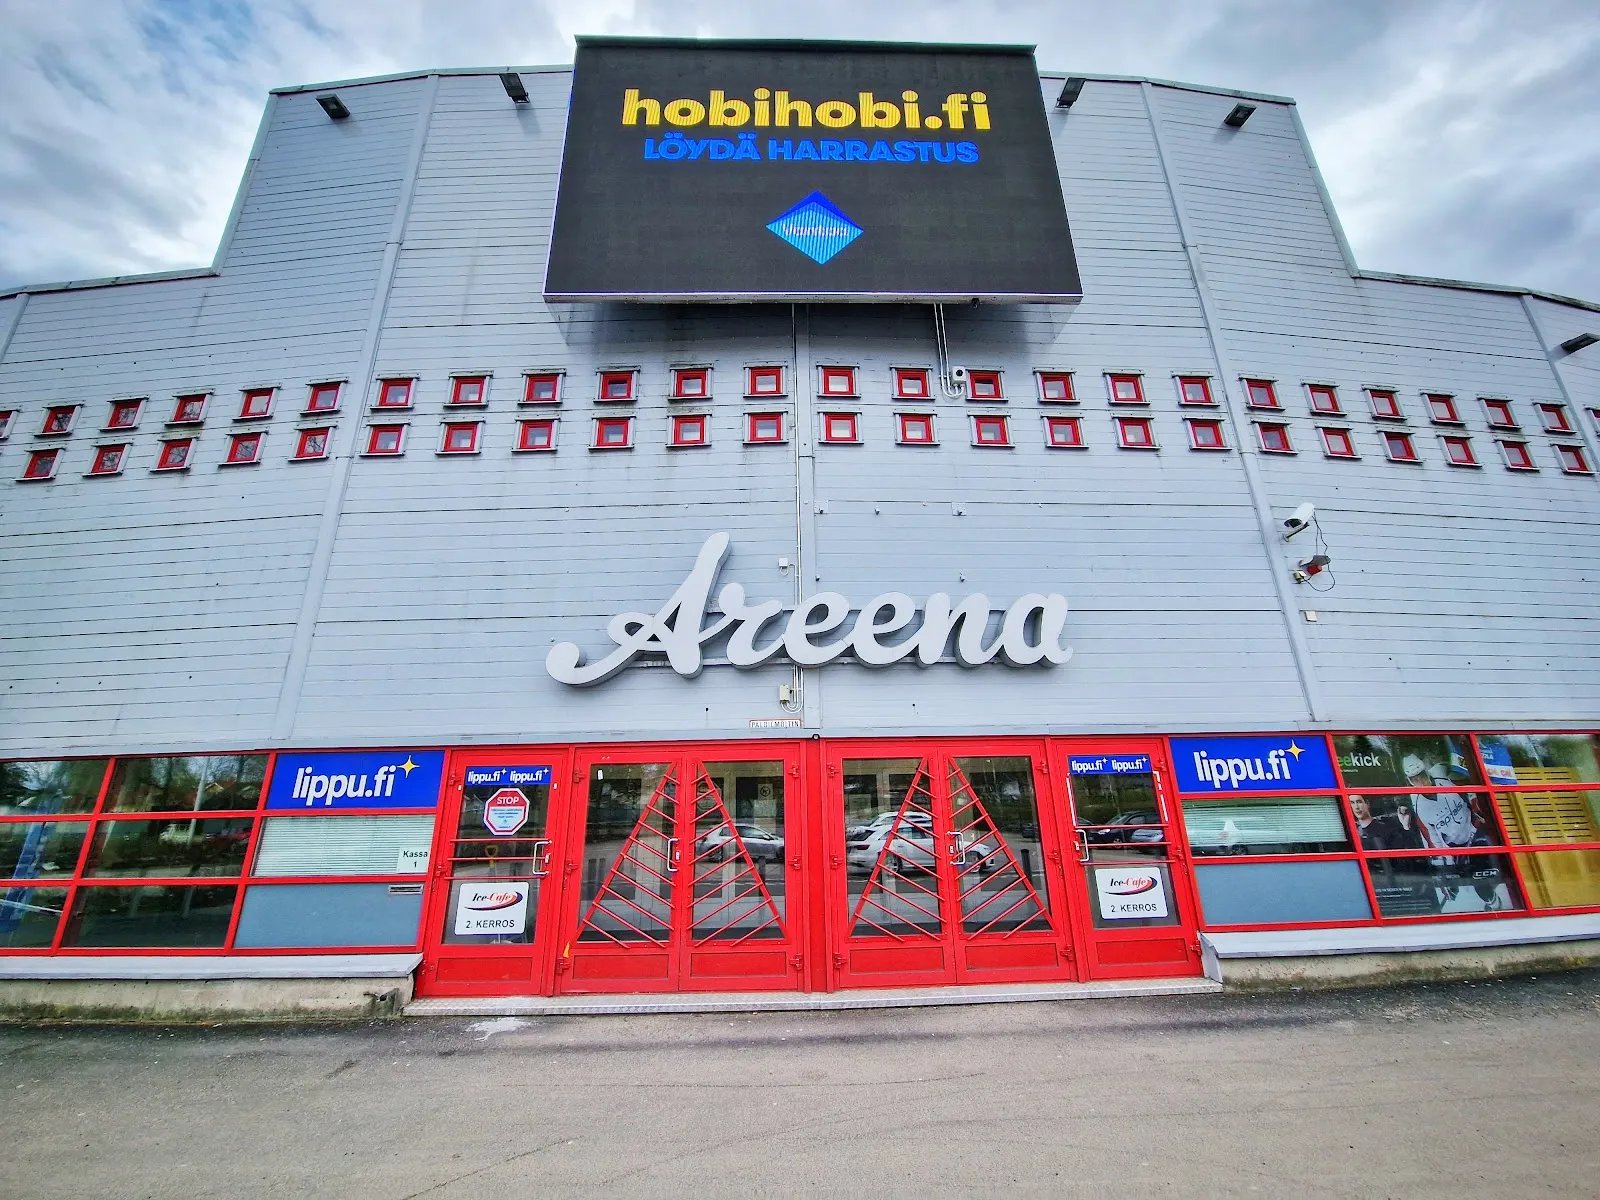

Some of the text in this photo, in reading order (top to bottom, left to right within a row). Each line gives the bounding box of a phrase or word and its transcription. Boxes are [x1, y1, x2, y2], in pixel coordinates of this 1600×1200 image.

[622, 87, 992, 130] hobihobi.fi
[643, 132, 980, 163] LÖYDÄ HARRASTUS
[545, 531, 1073, 687] Areena
[1071, 759, 1143, 773] lippu.fi lippu.fi
[1193, 749, 1291, 788] lippu.fi
[467, 770, 543, 784] lippu.fi lippu.fi
[292, 765, 397, 806] lippu.fi
[496, 796, 520, 805] STOP
[402, 850, 429, 858] Kassa
[1111, 903, 1158, 913] 2. KERROS
[465, 920, 515, 929] 2. KERROS
